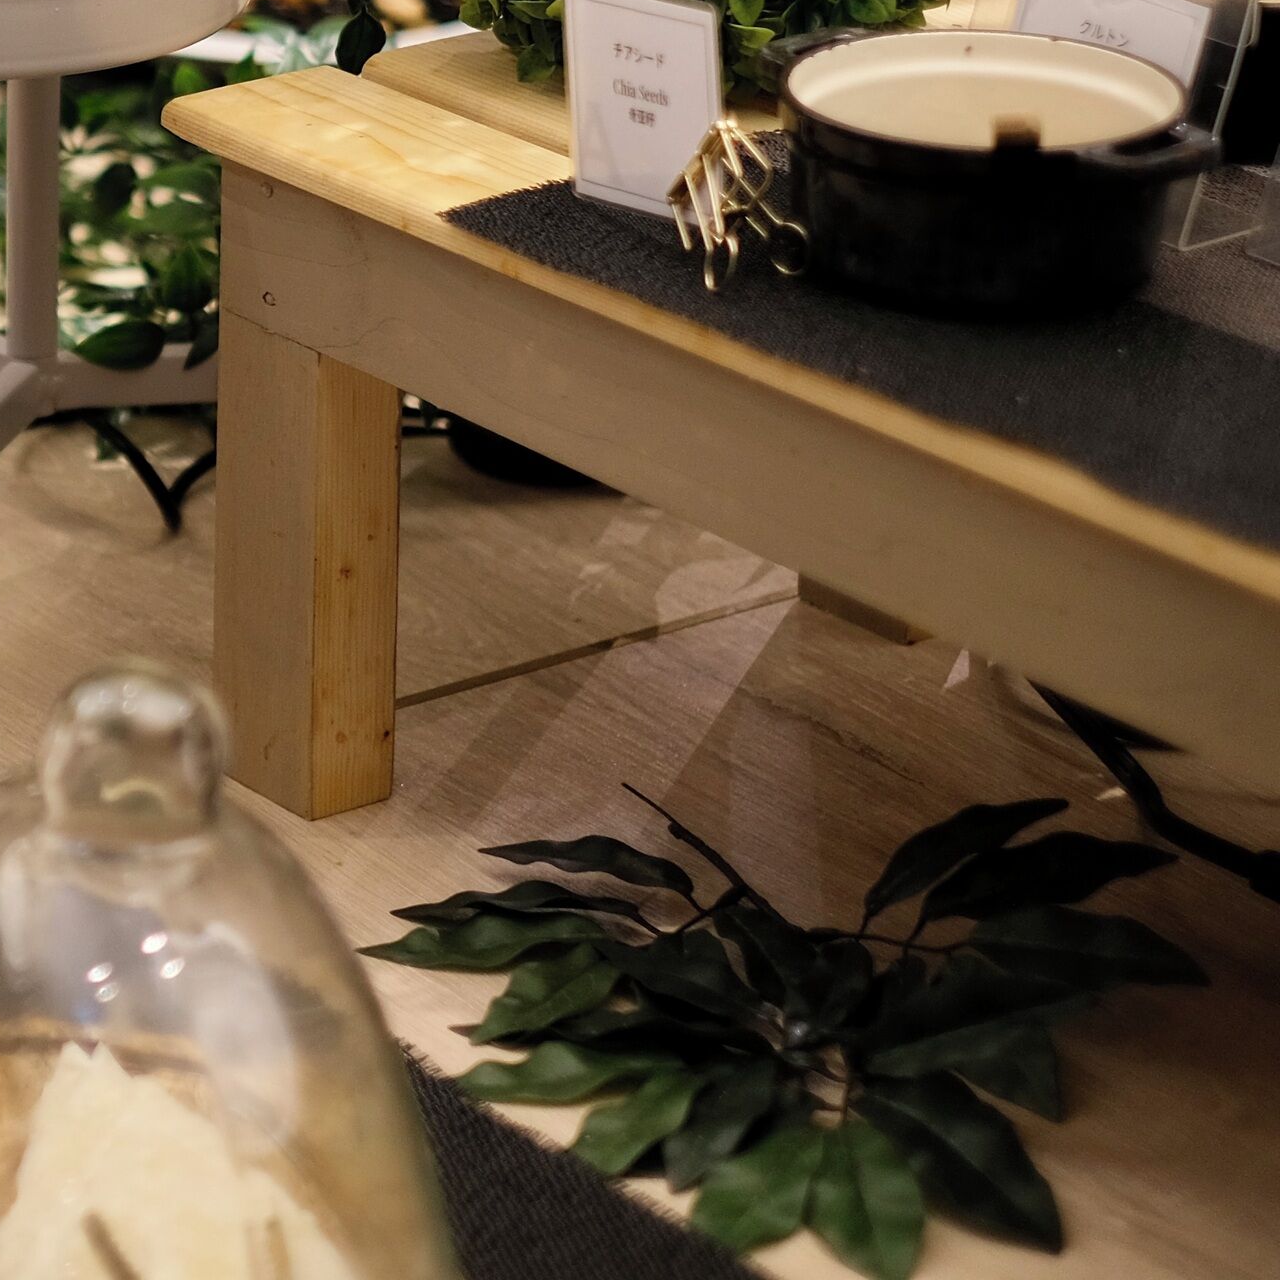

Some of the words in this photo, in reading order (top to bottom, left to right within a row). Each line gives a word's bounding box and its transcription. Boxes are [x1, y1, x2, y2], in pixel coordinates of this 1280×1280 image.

[1078, 20, 1129, 48] クルトン
[612, 43, 664, 69] チアシード
[612, 79, 637, 99] Chia
[639, 85, 669, 107] Seeds
